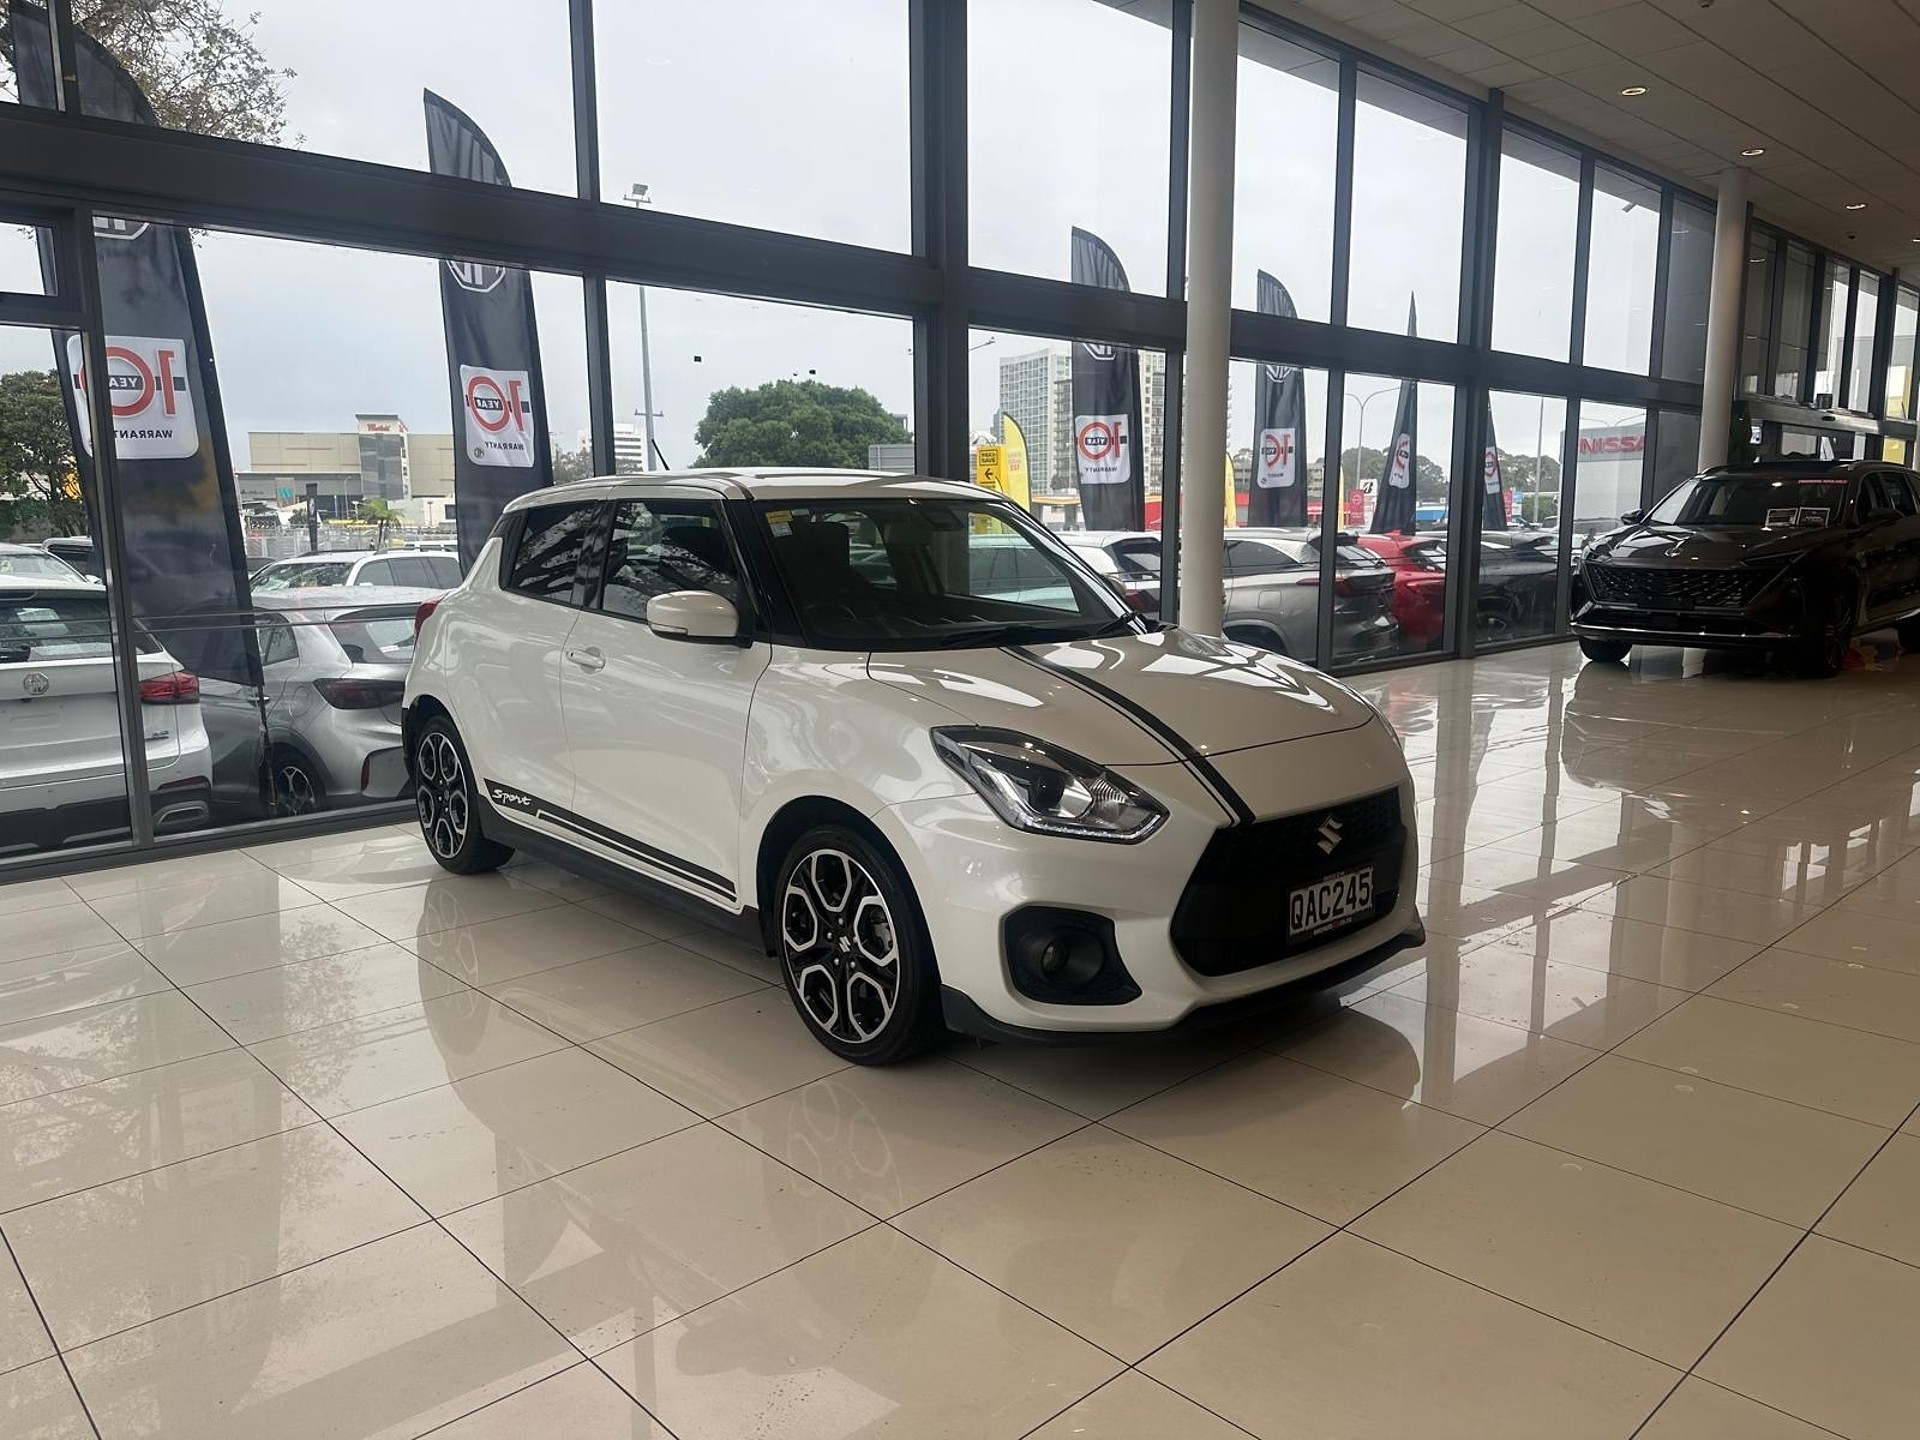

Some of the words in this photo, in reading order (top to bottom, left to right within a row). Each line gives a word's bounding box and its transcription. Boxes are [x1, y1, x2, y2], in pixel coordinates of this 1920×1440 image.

[1580, 435, 1648, 455] NISSA
[492, 789, 532, 805] Sport
[1291, 871, 1370, 930] QAC245
